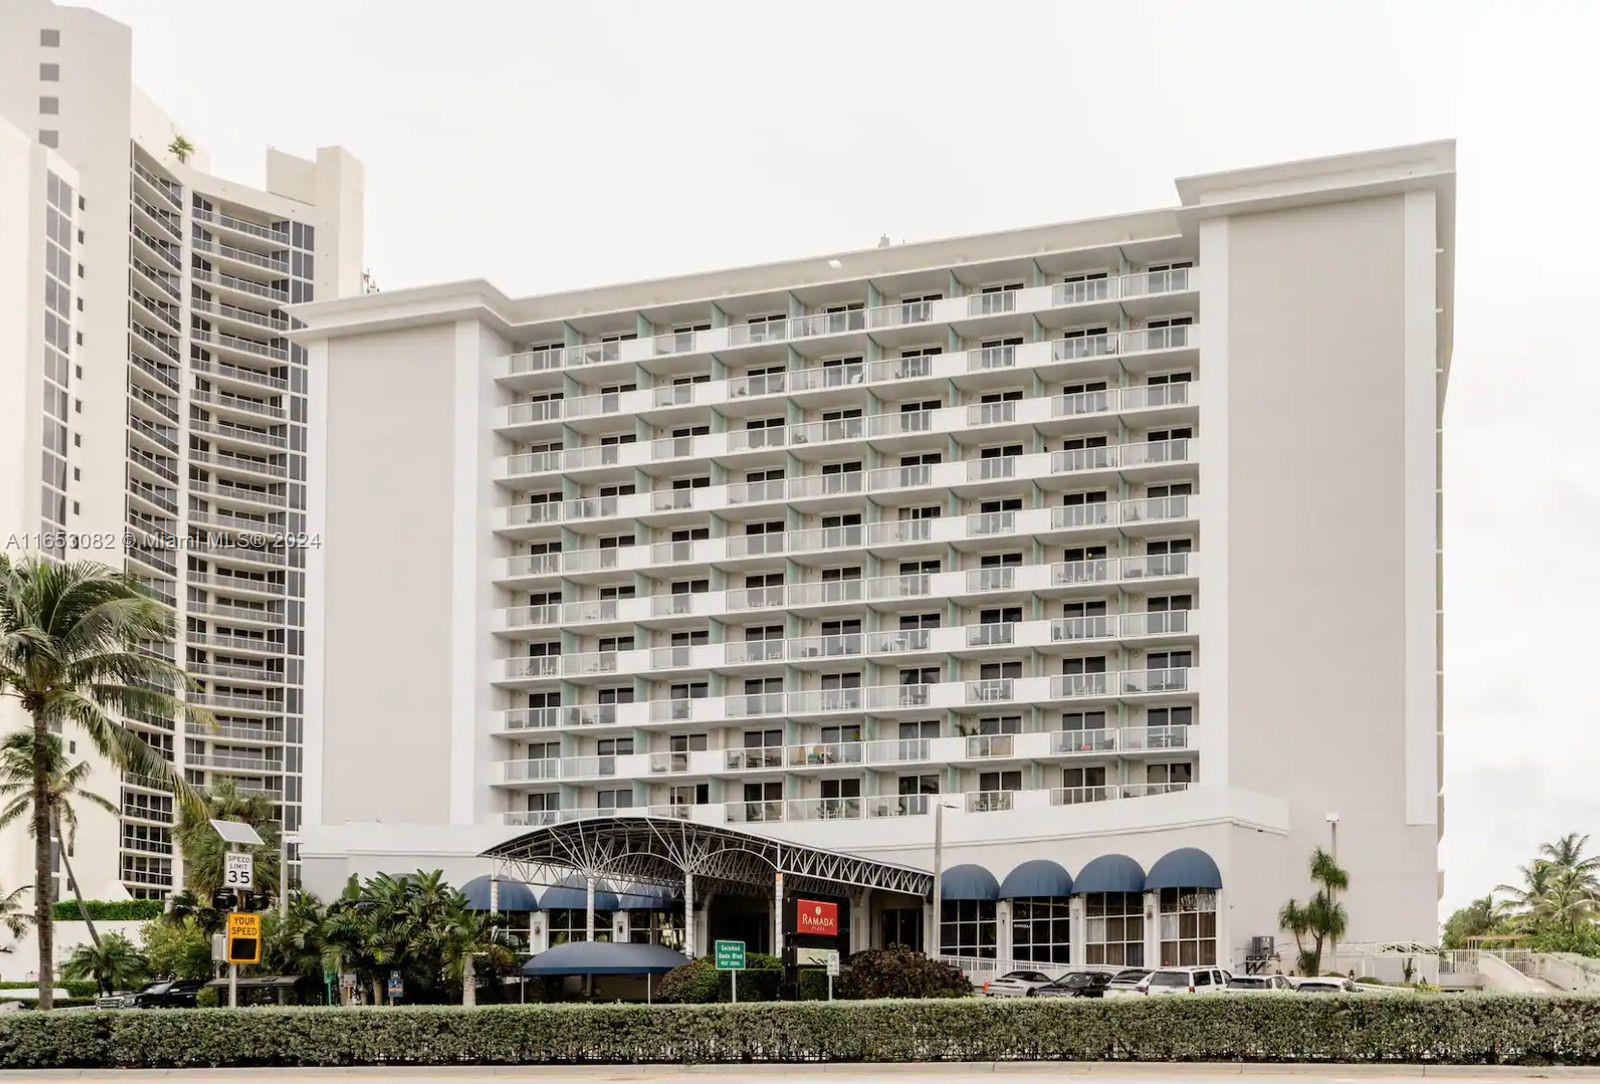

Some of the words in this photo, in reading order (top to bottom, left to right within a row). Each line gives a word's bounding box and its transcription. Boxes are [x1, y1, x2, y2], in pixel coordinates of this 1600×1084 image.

[228, 870, 250, 884] 35
[234, 916, 256, 926] YOUR
[802, 913, 834, 926] RAMADA
[232, 927, 257, 936] SPEED
